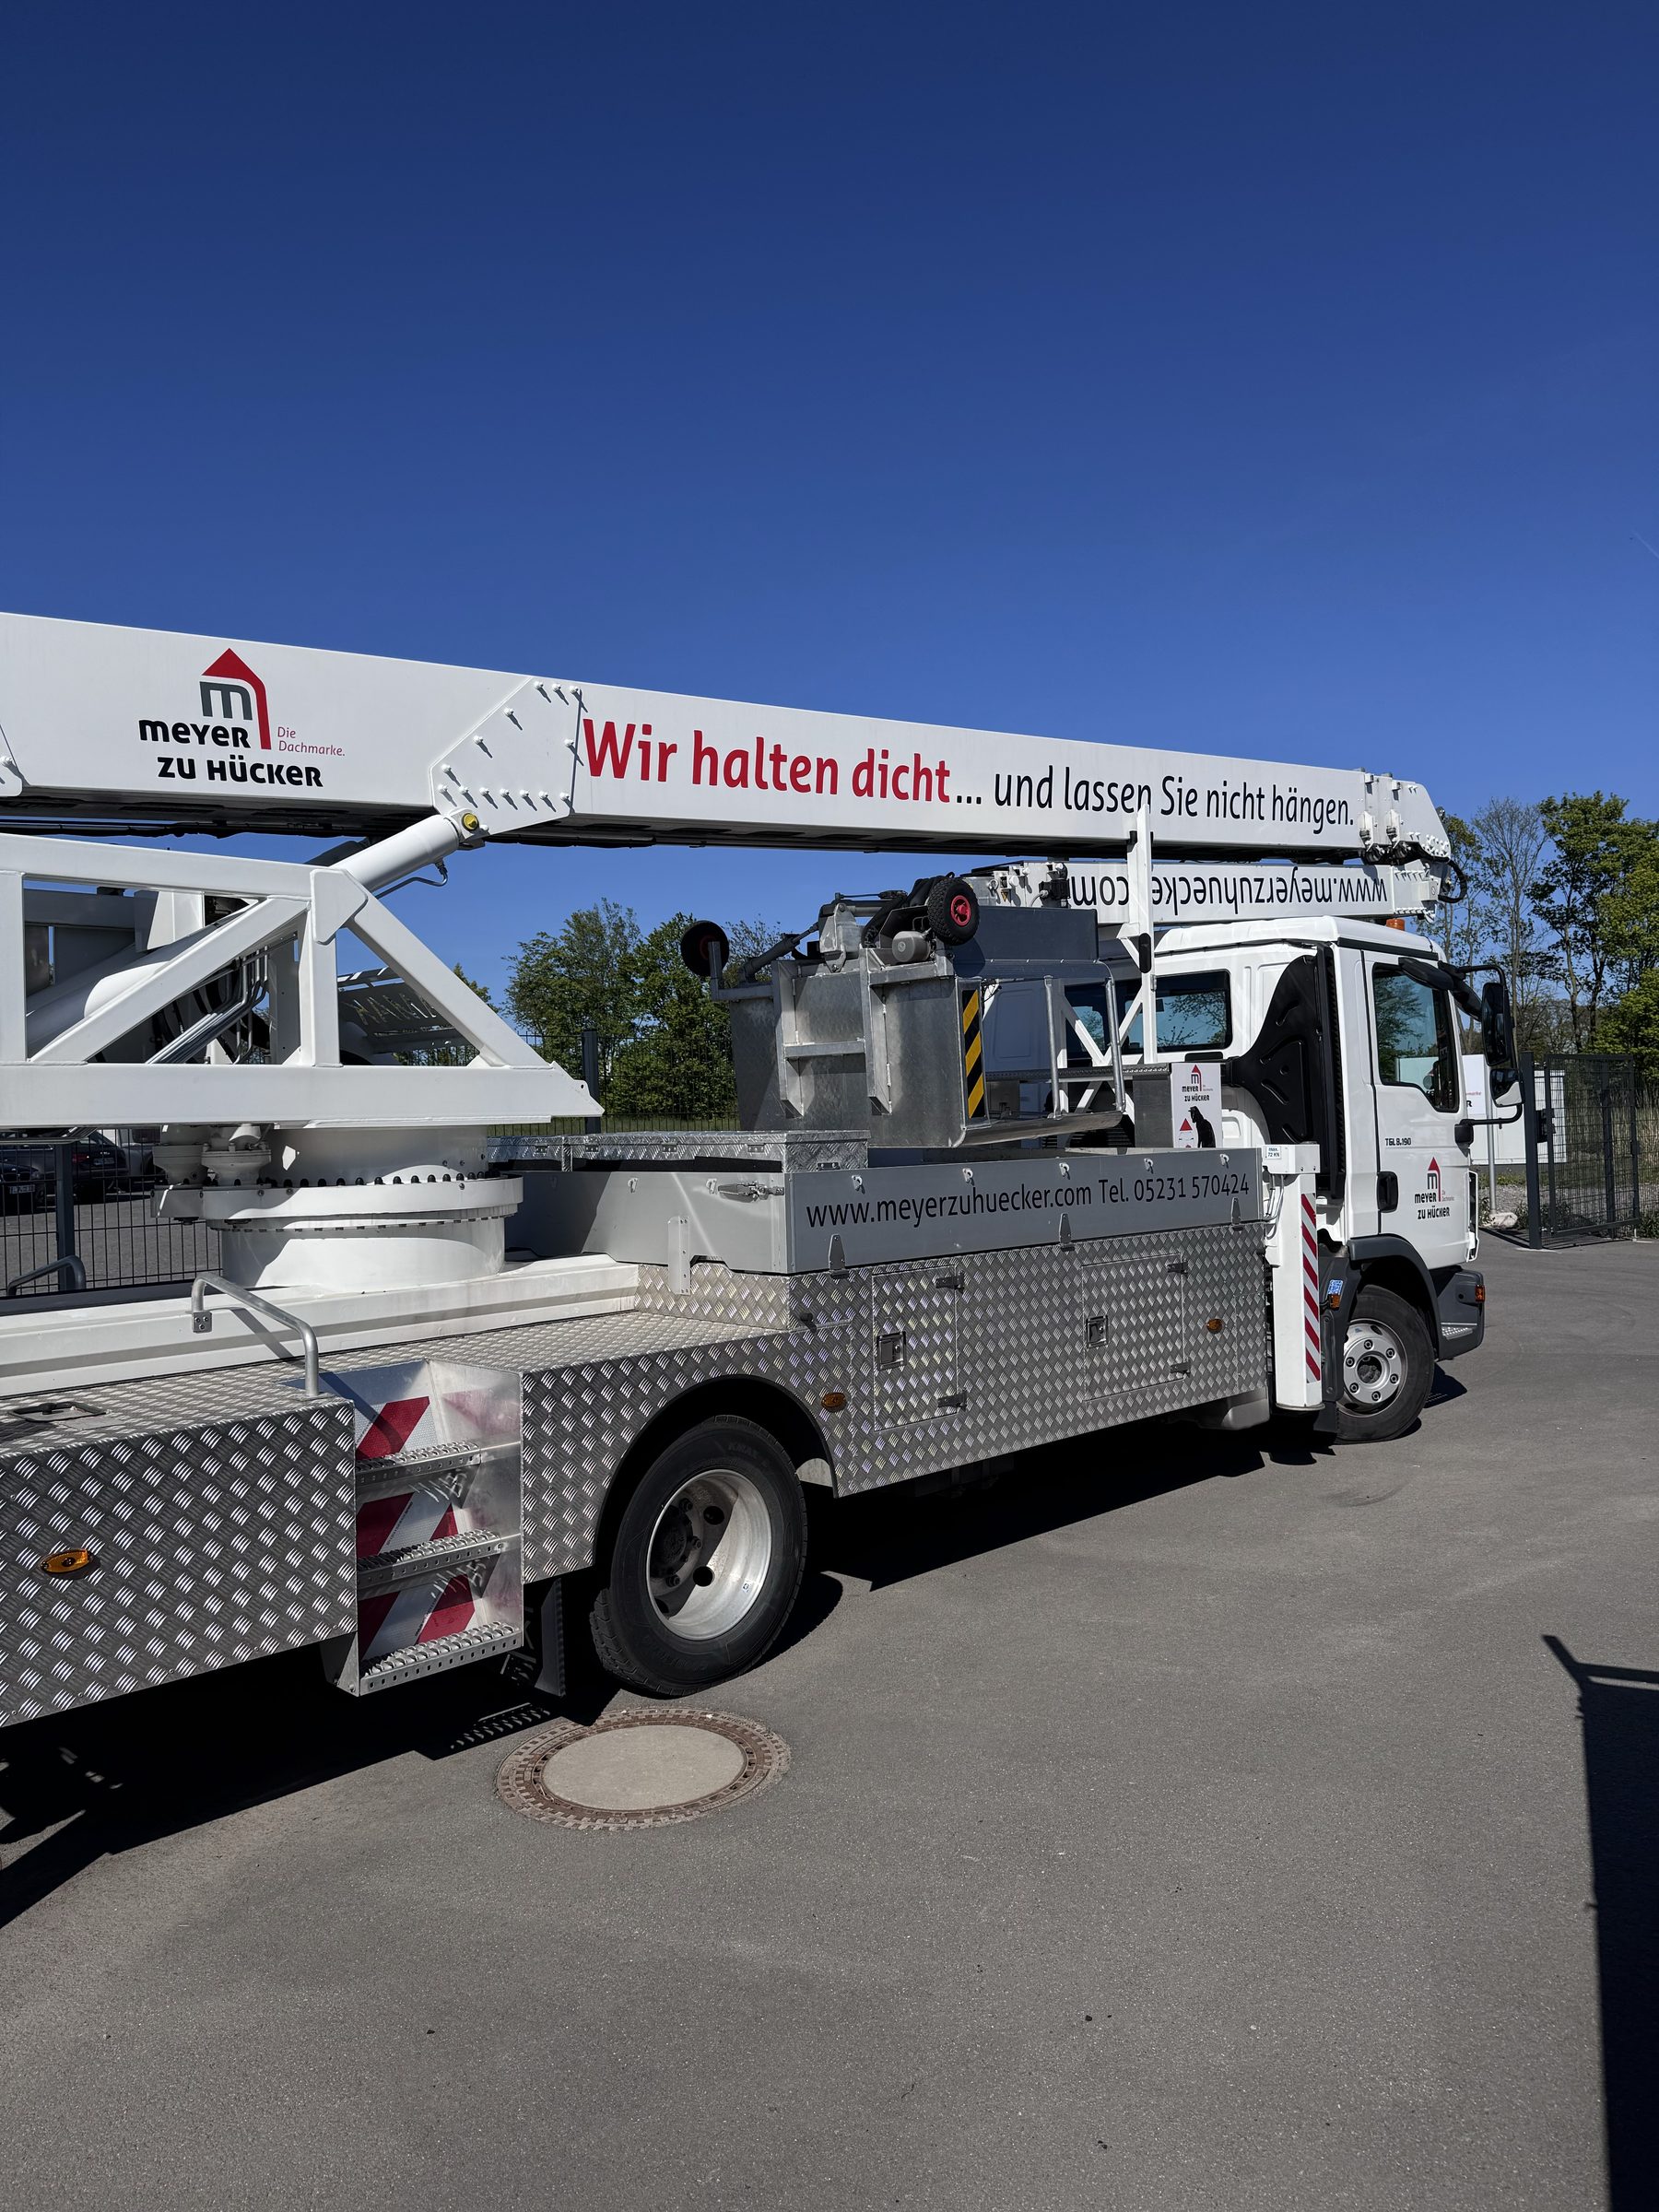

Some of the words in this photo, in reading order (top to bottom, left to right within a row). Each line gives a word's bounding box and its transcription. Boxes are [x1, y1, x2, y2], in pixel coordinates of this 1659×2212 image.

[277, 726, 296, 739] Die
[278, 740, 346, 757] Dachmarke.
[157, 756, 196, 780] ZU
[582, 718, 677, 782] Wir
[692, 729, 839, 795] halten
[994, 764, 1053, 809] und
[1064, 766, 1152, 814] lassen
[1160, 775, 1198, 818] Sie
[1206, 780, 1265, 821] nicht
[1272, 783, 1354, 835] hängen.
[806, 1182, 1092, 1230] www.meyerzuhuecker.com
[1098, 1177, 1129, 1204] Tel.
[1134, 1177, 1187, 1203] 05231
[1191, 1172, 1250, 1199] 570424
